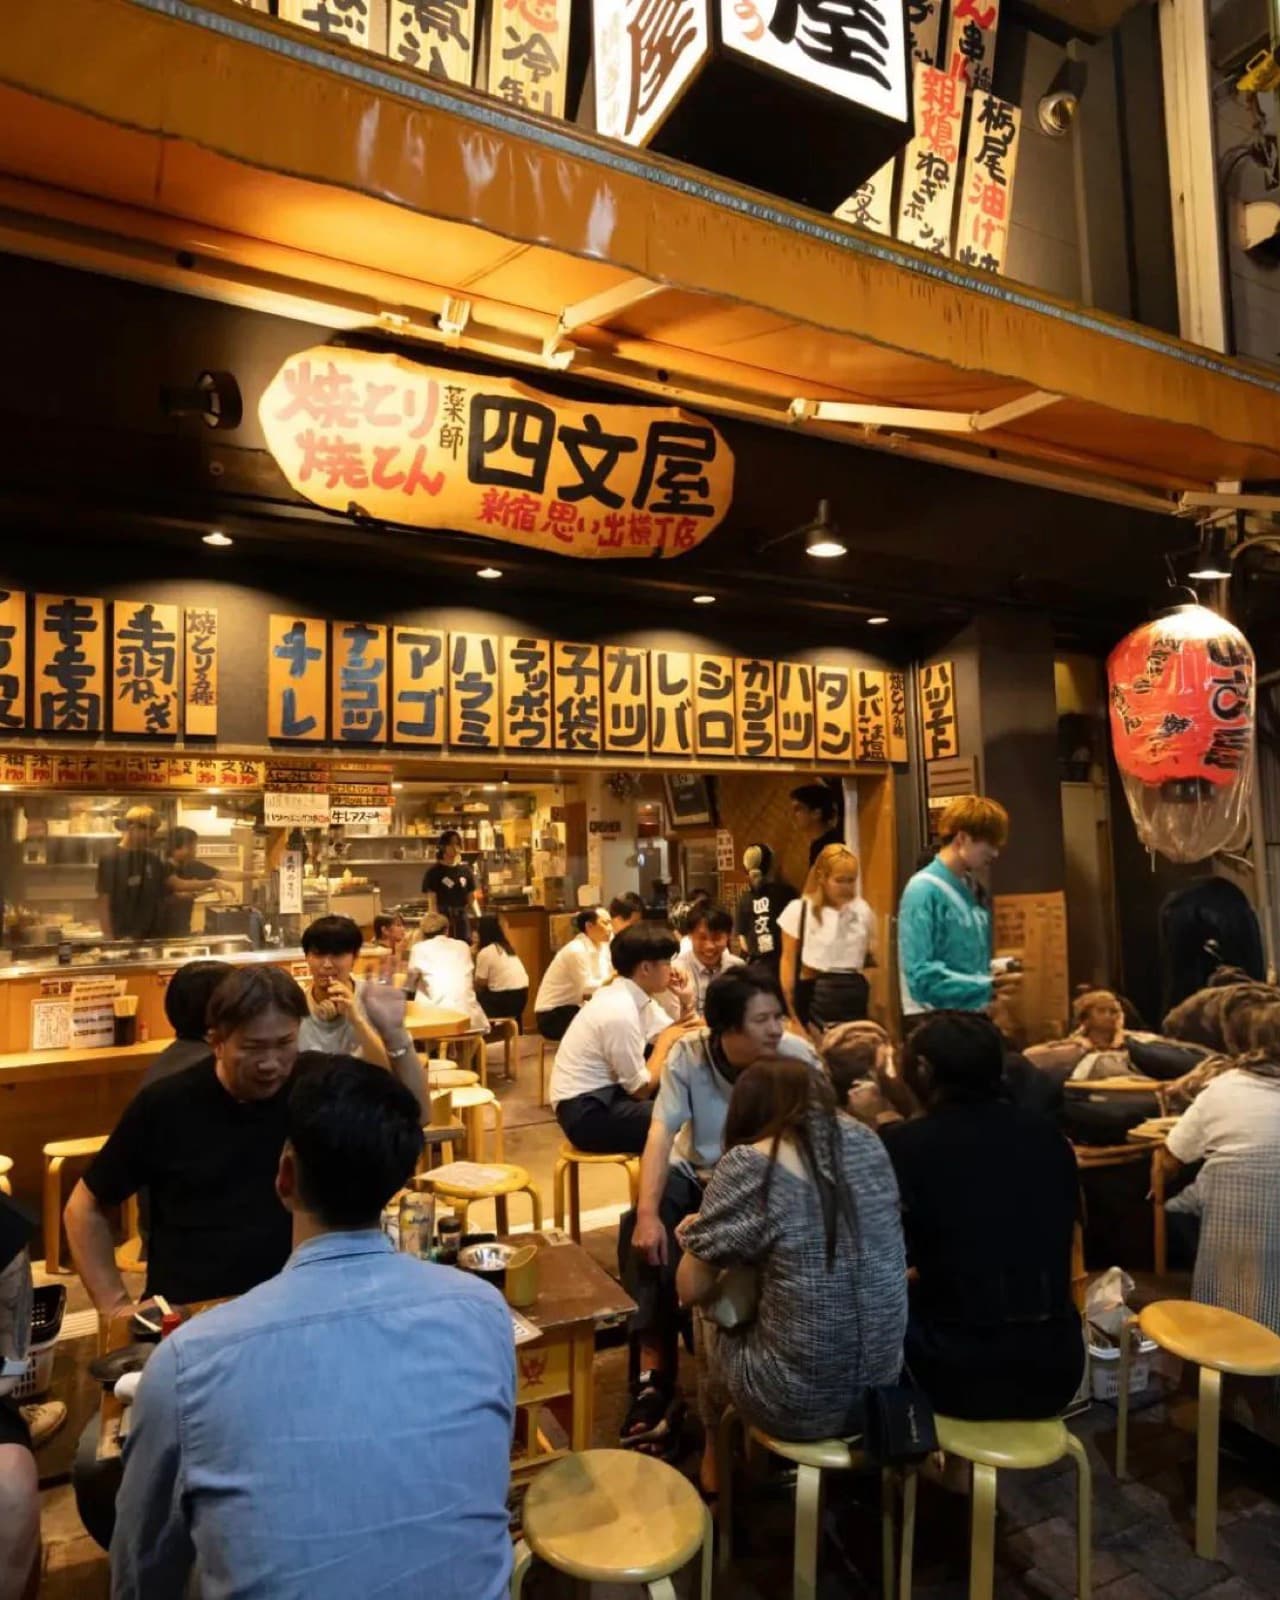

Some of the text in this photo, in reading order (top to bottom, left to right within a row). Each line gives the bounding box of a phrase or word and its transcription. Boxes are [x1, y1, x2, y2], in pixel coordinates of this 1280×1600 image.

[276, 361, 440, 440] 焼とり
[294, 427, 445, 497] 焼とん
[467, 392, 716, 518] 四文屋
[476, 487, 698, 549] 新宿思い出横丁店
[40, 598, 101, 731] もも肉
[273, 620, 323, 737] チレ
[341, 621, 385, 741] ナンコツ
[396, 631, 445, 738] アゴ
[451, 635, 497, 747] ハラミ
[506, 638, 549, 747] テッポウ
[556, 644, 600, 750] 子袋
[607, 648, 648, 748] ガツ
[651, 653, 693, 751] レバ
[697, 660, 735, 749] シロ
[741, 660, 774, 756] カシラ
[779, 665, 813, 752] ハツ
[817, 671, 851, 754] タン
[922, 664, 954, 759] ハツモト
